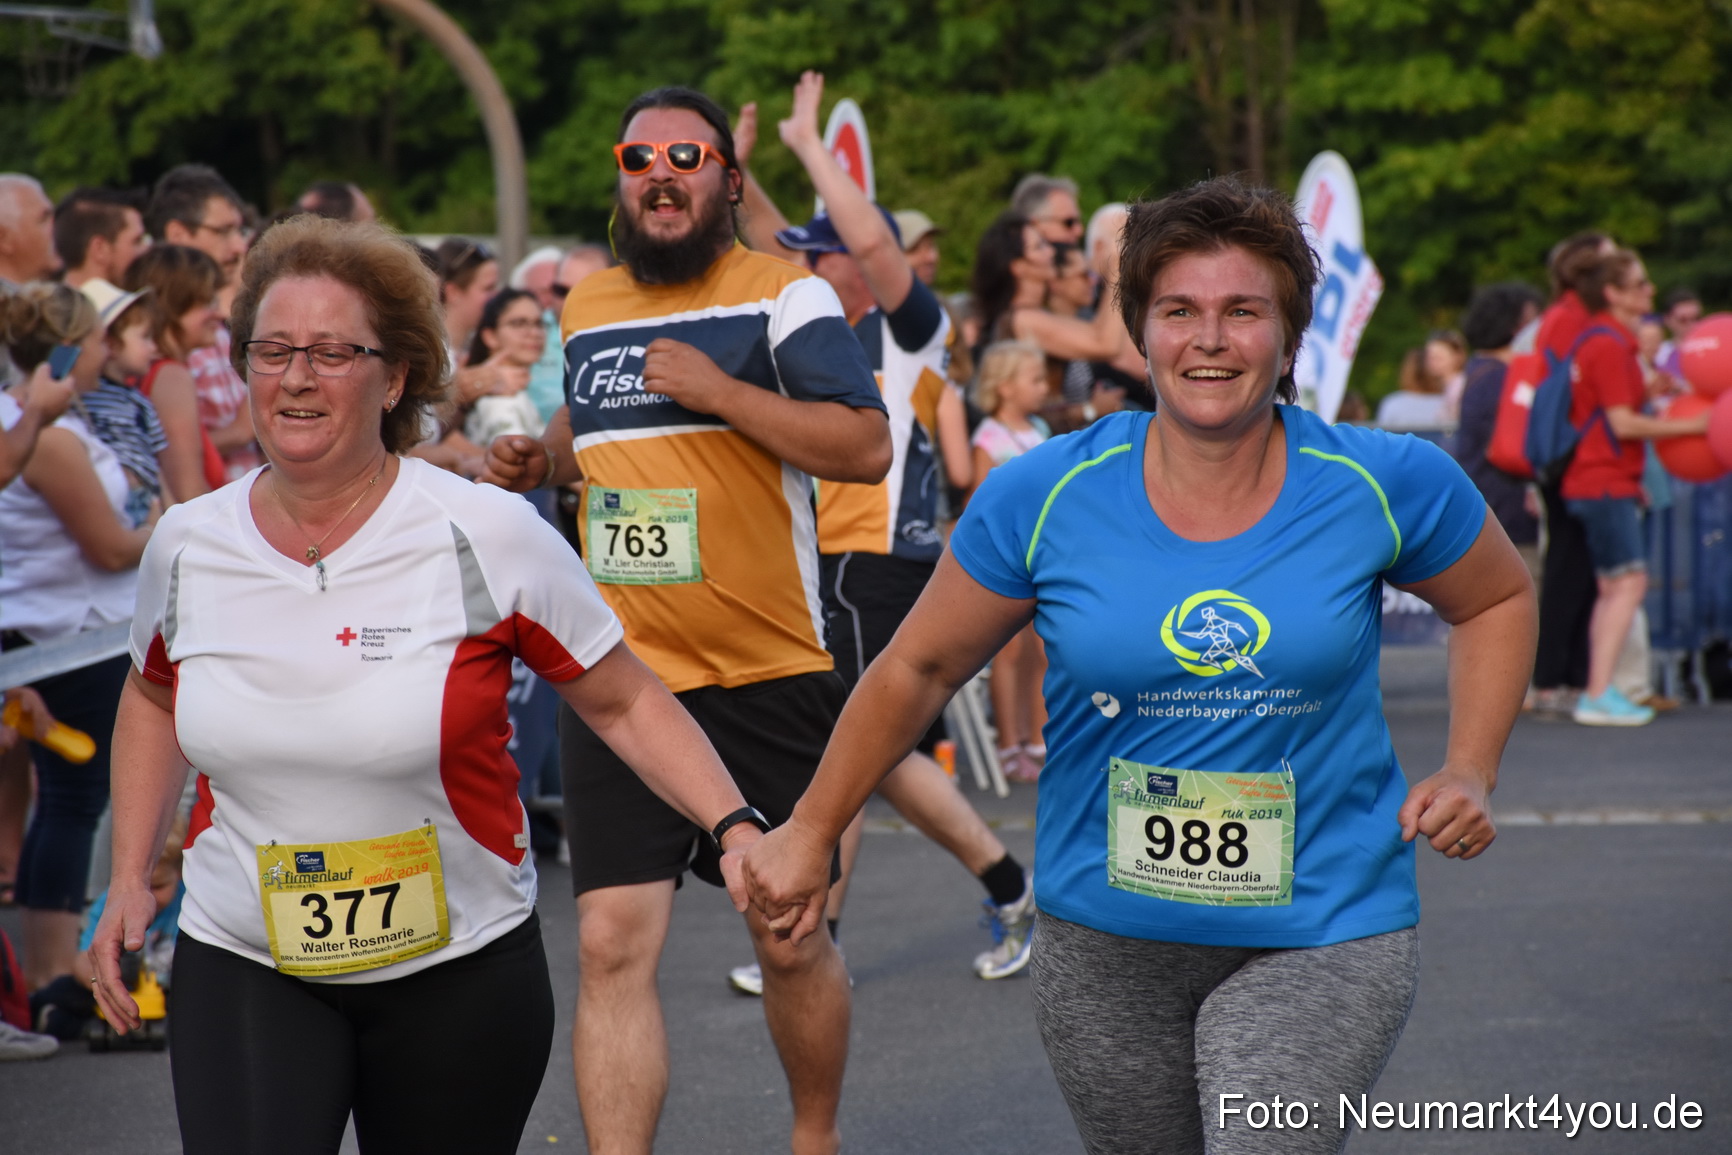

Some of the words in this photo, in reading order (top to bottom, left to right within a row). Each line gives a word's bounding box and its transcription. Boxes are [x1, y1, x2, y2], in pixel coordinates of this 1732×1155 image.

[604, 523, 668, 558] 763
[633, 559, 675, 569] Christian
[361, 626, 412, 634] Bayerisches
[1137, 686, 1303, 702] Handwerkskammer
[1137, 700, 1323, 722] Niederbayern-Oberpfalz
[1134, 788, 1205, 810] firmenlauf
[1249, 808, 1283, 820] 2019
[1144, 814, 1249, 869] 988
[285, 867, 354, 884] firmenlauf
[363, 867, 395, 885] walk
[397, 862, 429, 880] 2019
[1117, 867, 1186, 888] Handwerkskammer
[1187, 881, 1280, 893] Niederbayern-Oberpfalz
[1135, 859, 1203, 881] Schneider
[1207, 870, 1262, 883] Claudia
[300, 882, 401, 940] 377
[280, 954, 295, 962] BRK
[295, 952, 350, 963] Seniorenzentren
[351, 944, 393, 959] Woffenbach
[394, 940, 407, 950] und
[408, 930, 440, 945] Neumarkt
[301, 940, 346, 954] Walter
[349, 927, 415, 950] Rosmarie
